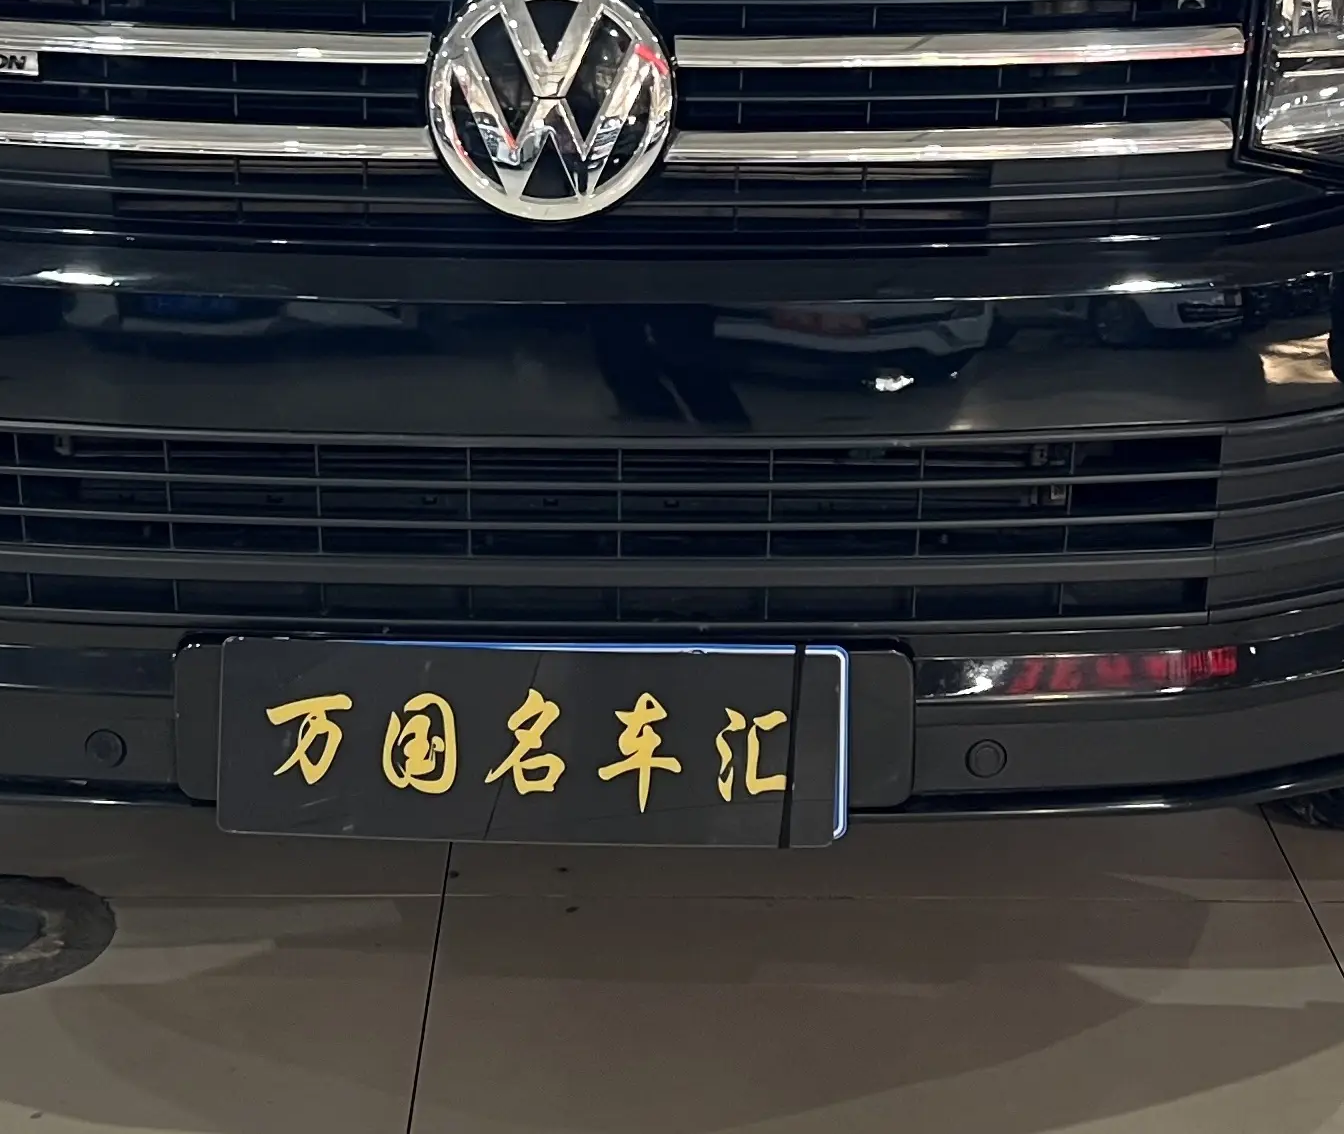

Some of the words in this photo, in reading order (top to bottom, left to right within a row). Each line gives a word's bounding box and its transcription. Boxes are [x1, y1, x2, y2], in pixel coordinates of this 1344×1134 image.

[265, 689, 788, 814] 万国名车汇
